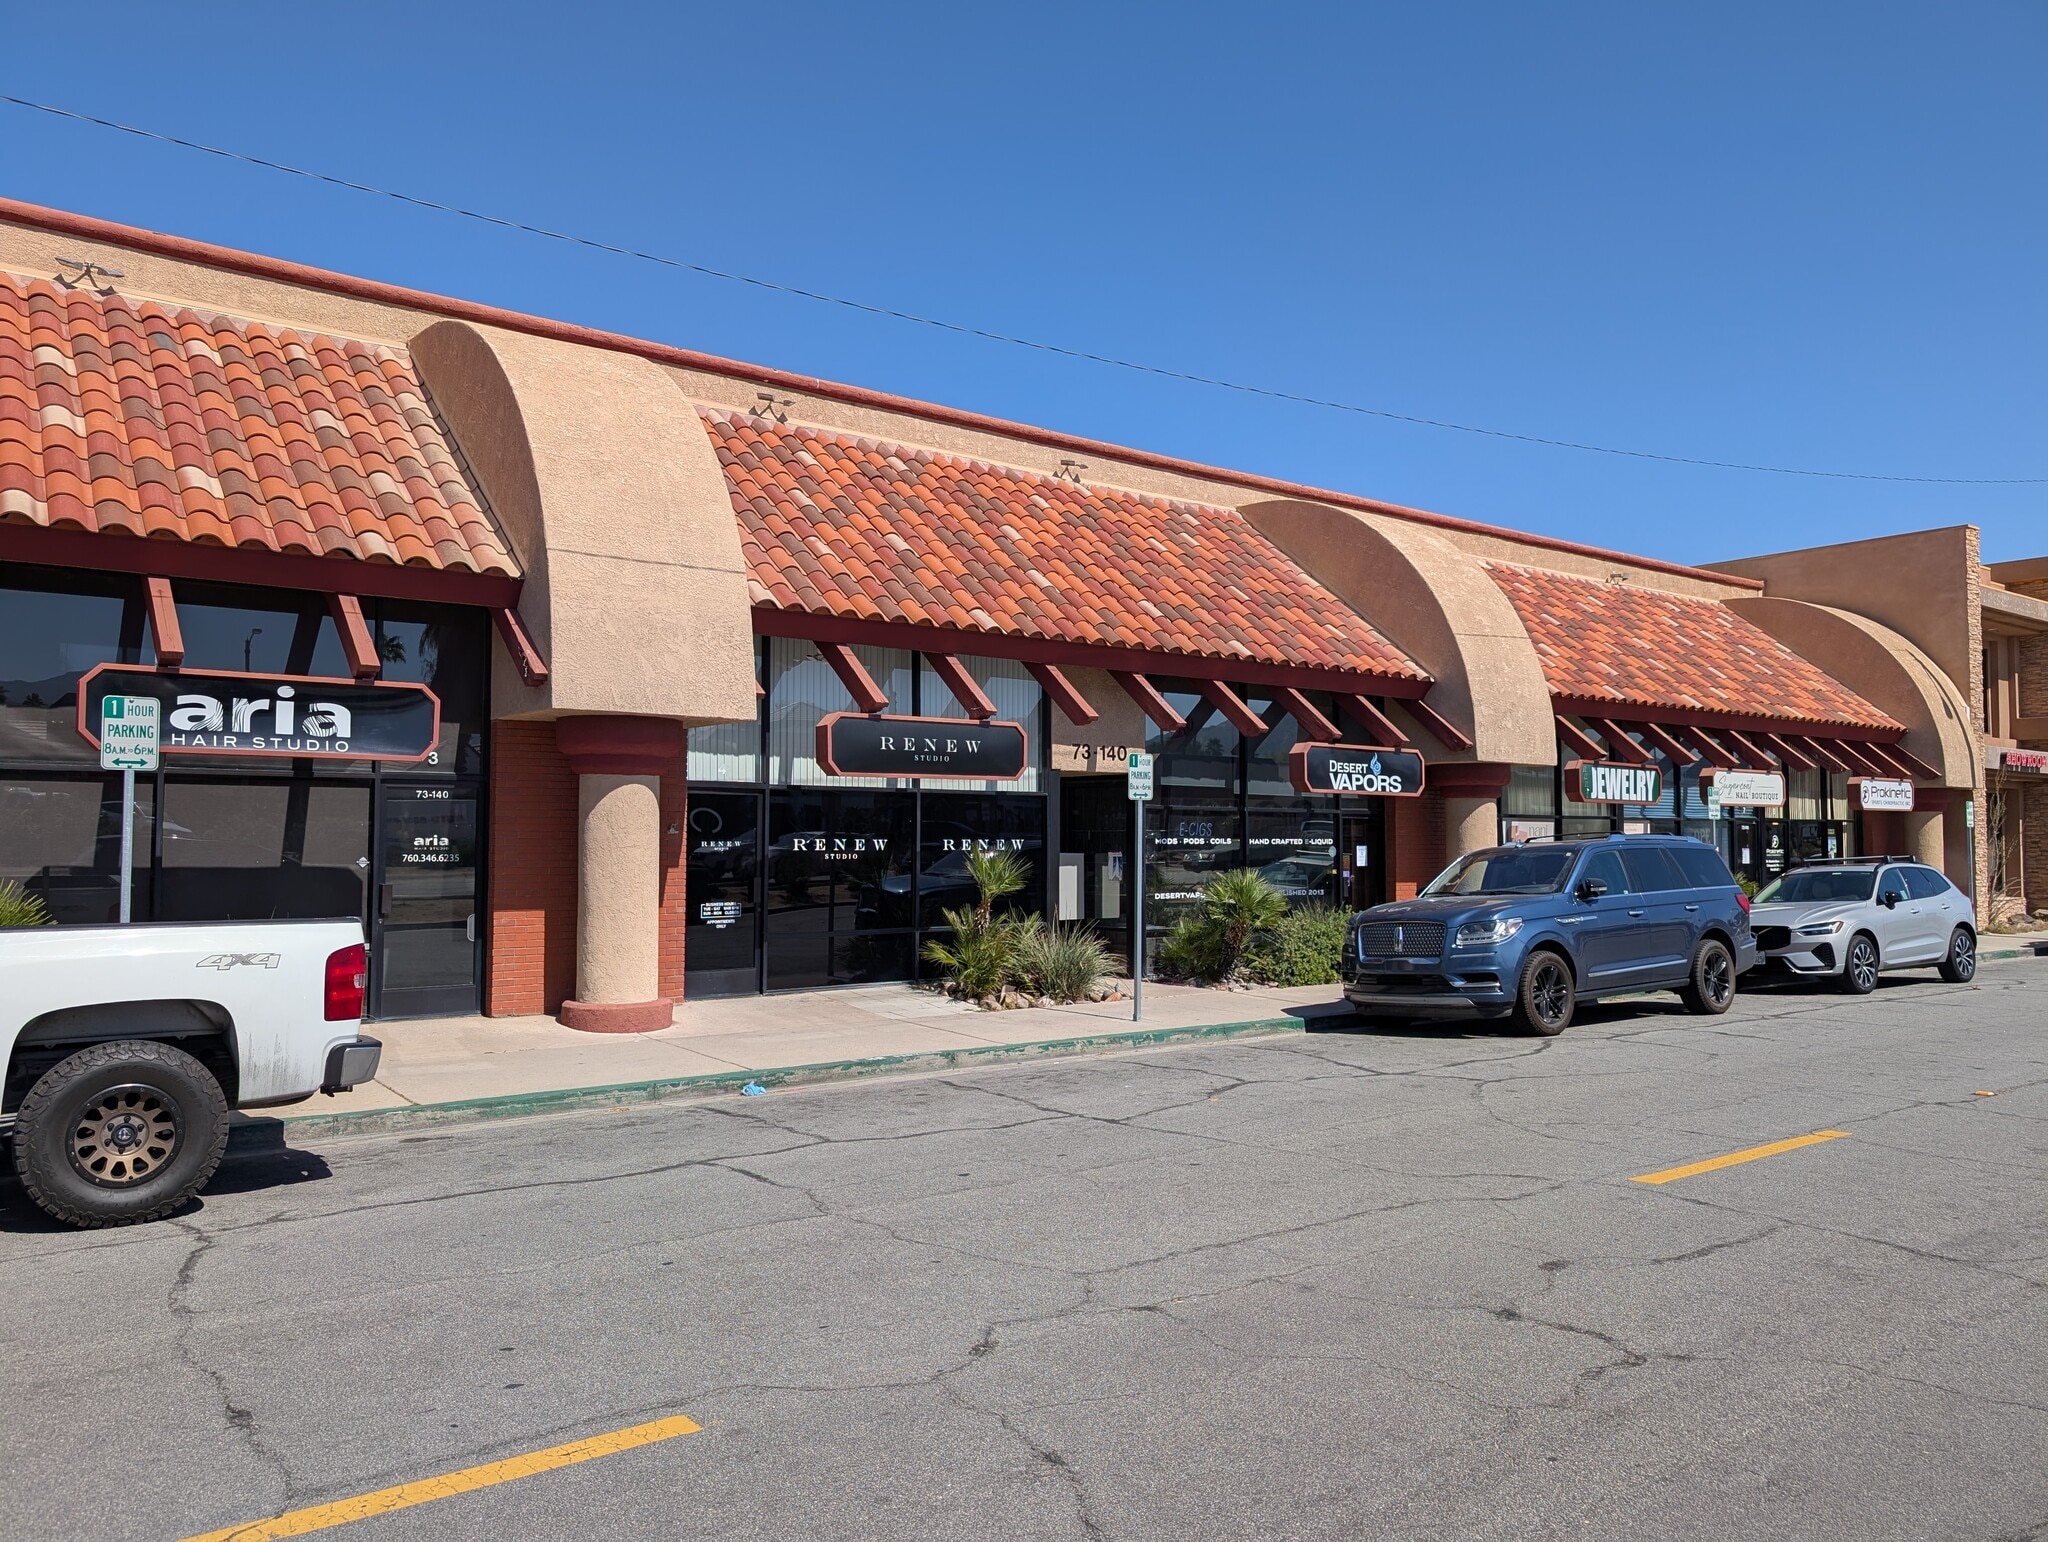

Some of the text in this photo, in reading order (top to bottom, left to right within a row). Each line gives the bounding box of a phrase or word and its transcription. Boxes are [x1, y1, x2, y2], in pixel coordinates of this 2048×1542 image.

[111, 700, 154, 717] 1 HOUR
[169, 685, 351, 738] aria
[107, 724, 154, 739] PARKING
[171, 733, 349, 752] HAIR STUDIO
[880, 736, 981, 753] RENEW
[428, 752, 438, 765] 3
[914, 754, 950, 763] STUDIO
[1132, 755, 1136, 766] 1
[1329, 760, 1368, 774] DESERT
[1130, 771, 1151, 780] PARKING
[1329, 773, 1402, 793] VAPORS
[1591, 767, 1656, 801] JEWELRY
[416, 790, 449, 799] 73-140
[1871, 786, 1911, 798] Prokinetic
[1179, 822, 1213, 837] E-CIGS
[413, 834, 449, 846] aria
[793, 838, 888, 851] RENEW
[943, 838, 1024, 851] RENEW
[1304, 838, 1334, 846] E-LIQUID
[402, 854, 460, 863] 760.346.6235
[824, 853, 858, 861] STUDIO
